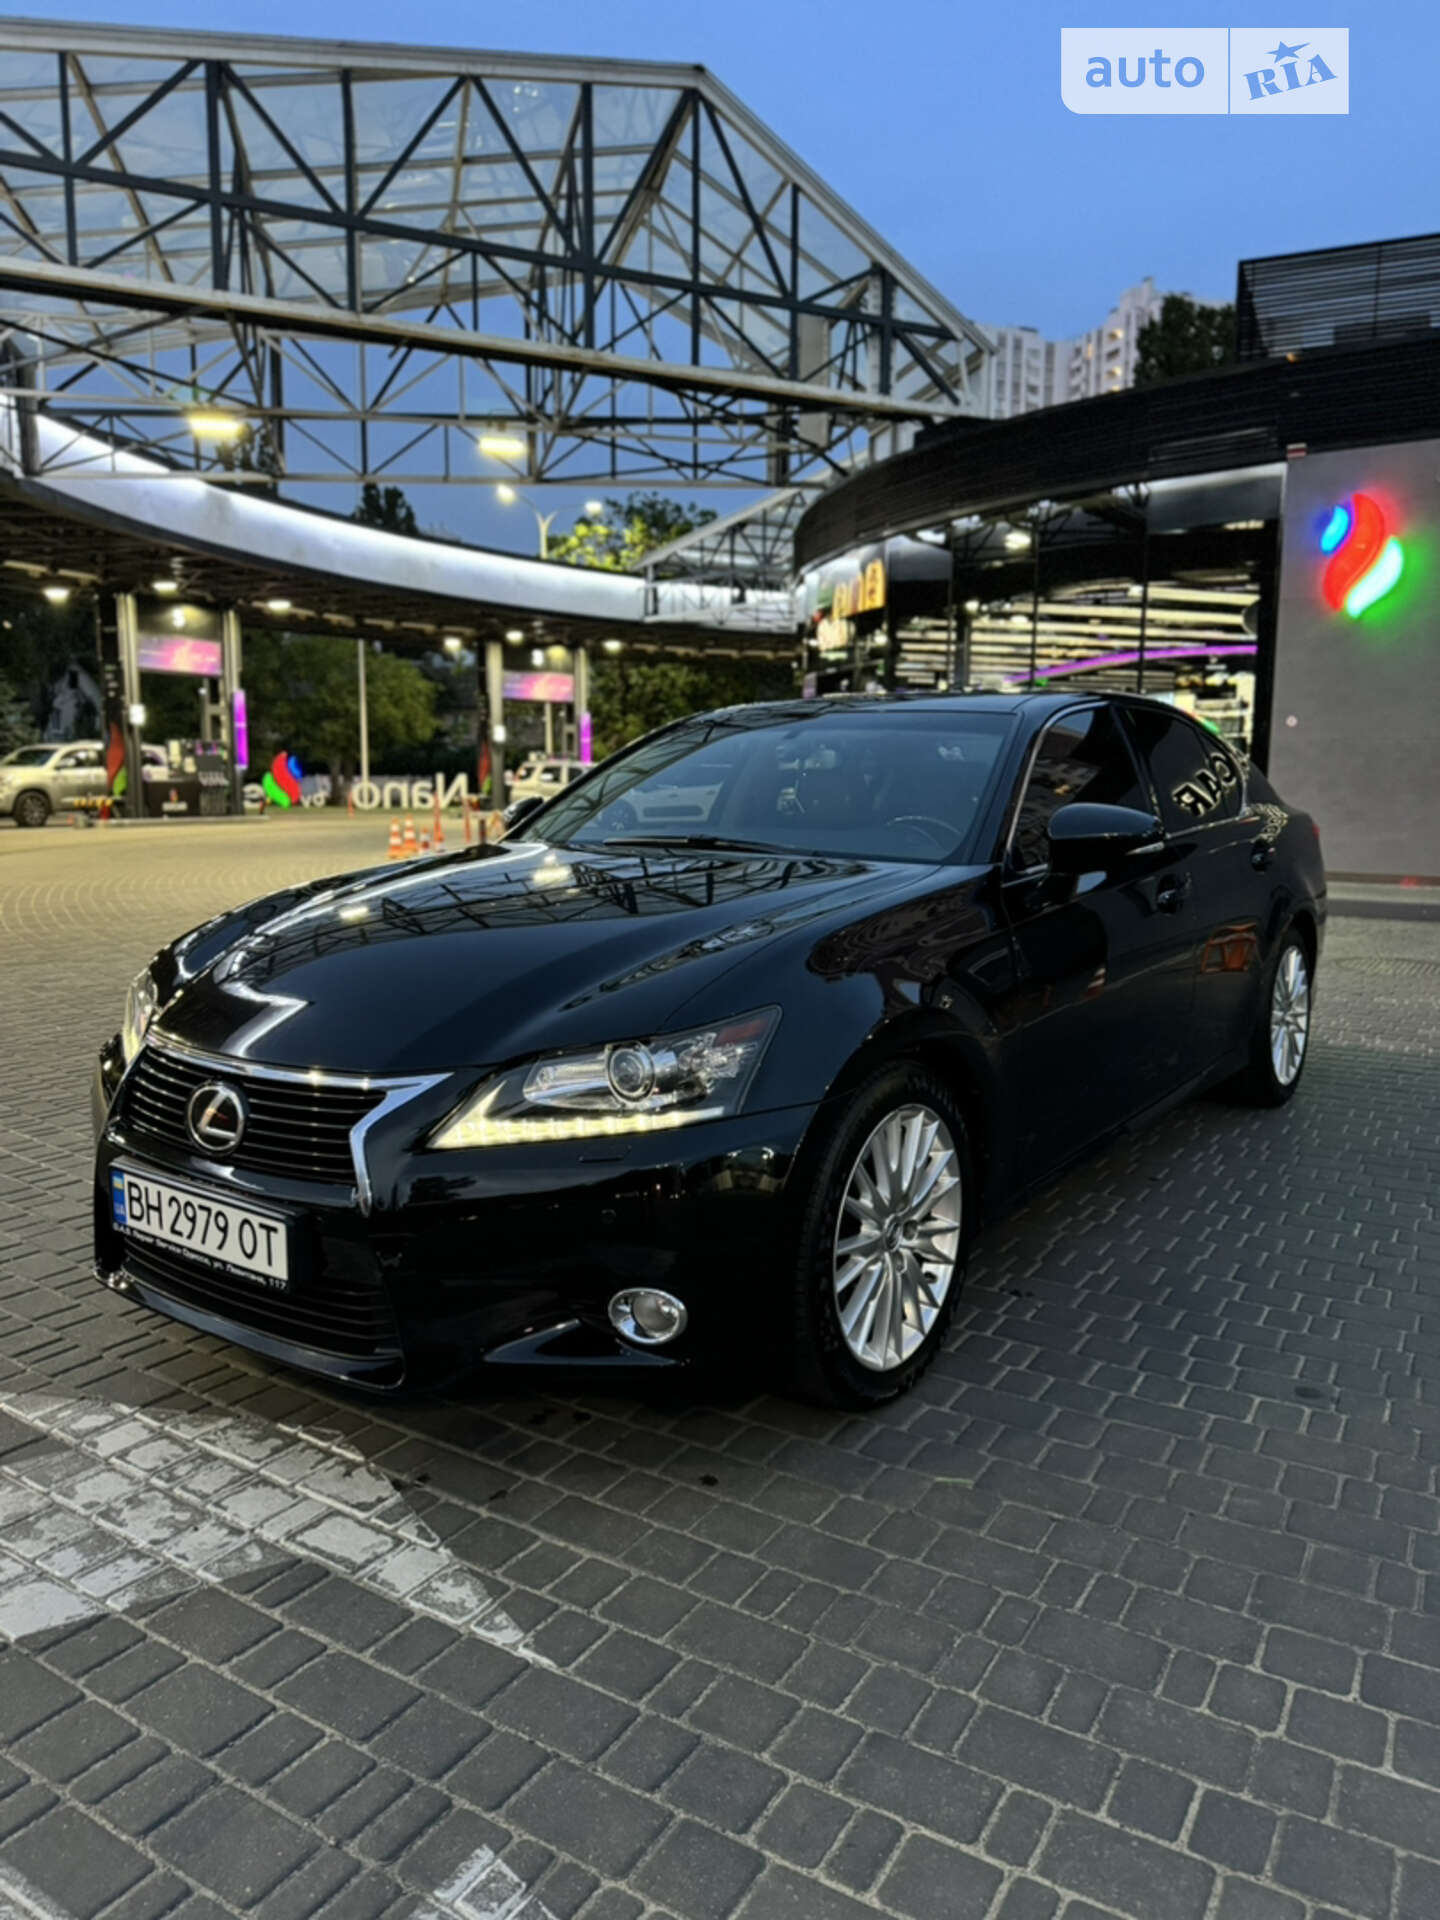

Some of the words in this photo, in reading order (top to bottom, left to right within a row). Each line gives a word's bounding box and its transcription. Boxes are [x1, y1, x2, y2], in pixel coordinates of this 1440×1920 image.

[127, 1181, 164, 1231] BH
[168, 1196, 230, 1251] 2979
[238, 1217, 279, 1267] OT
